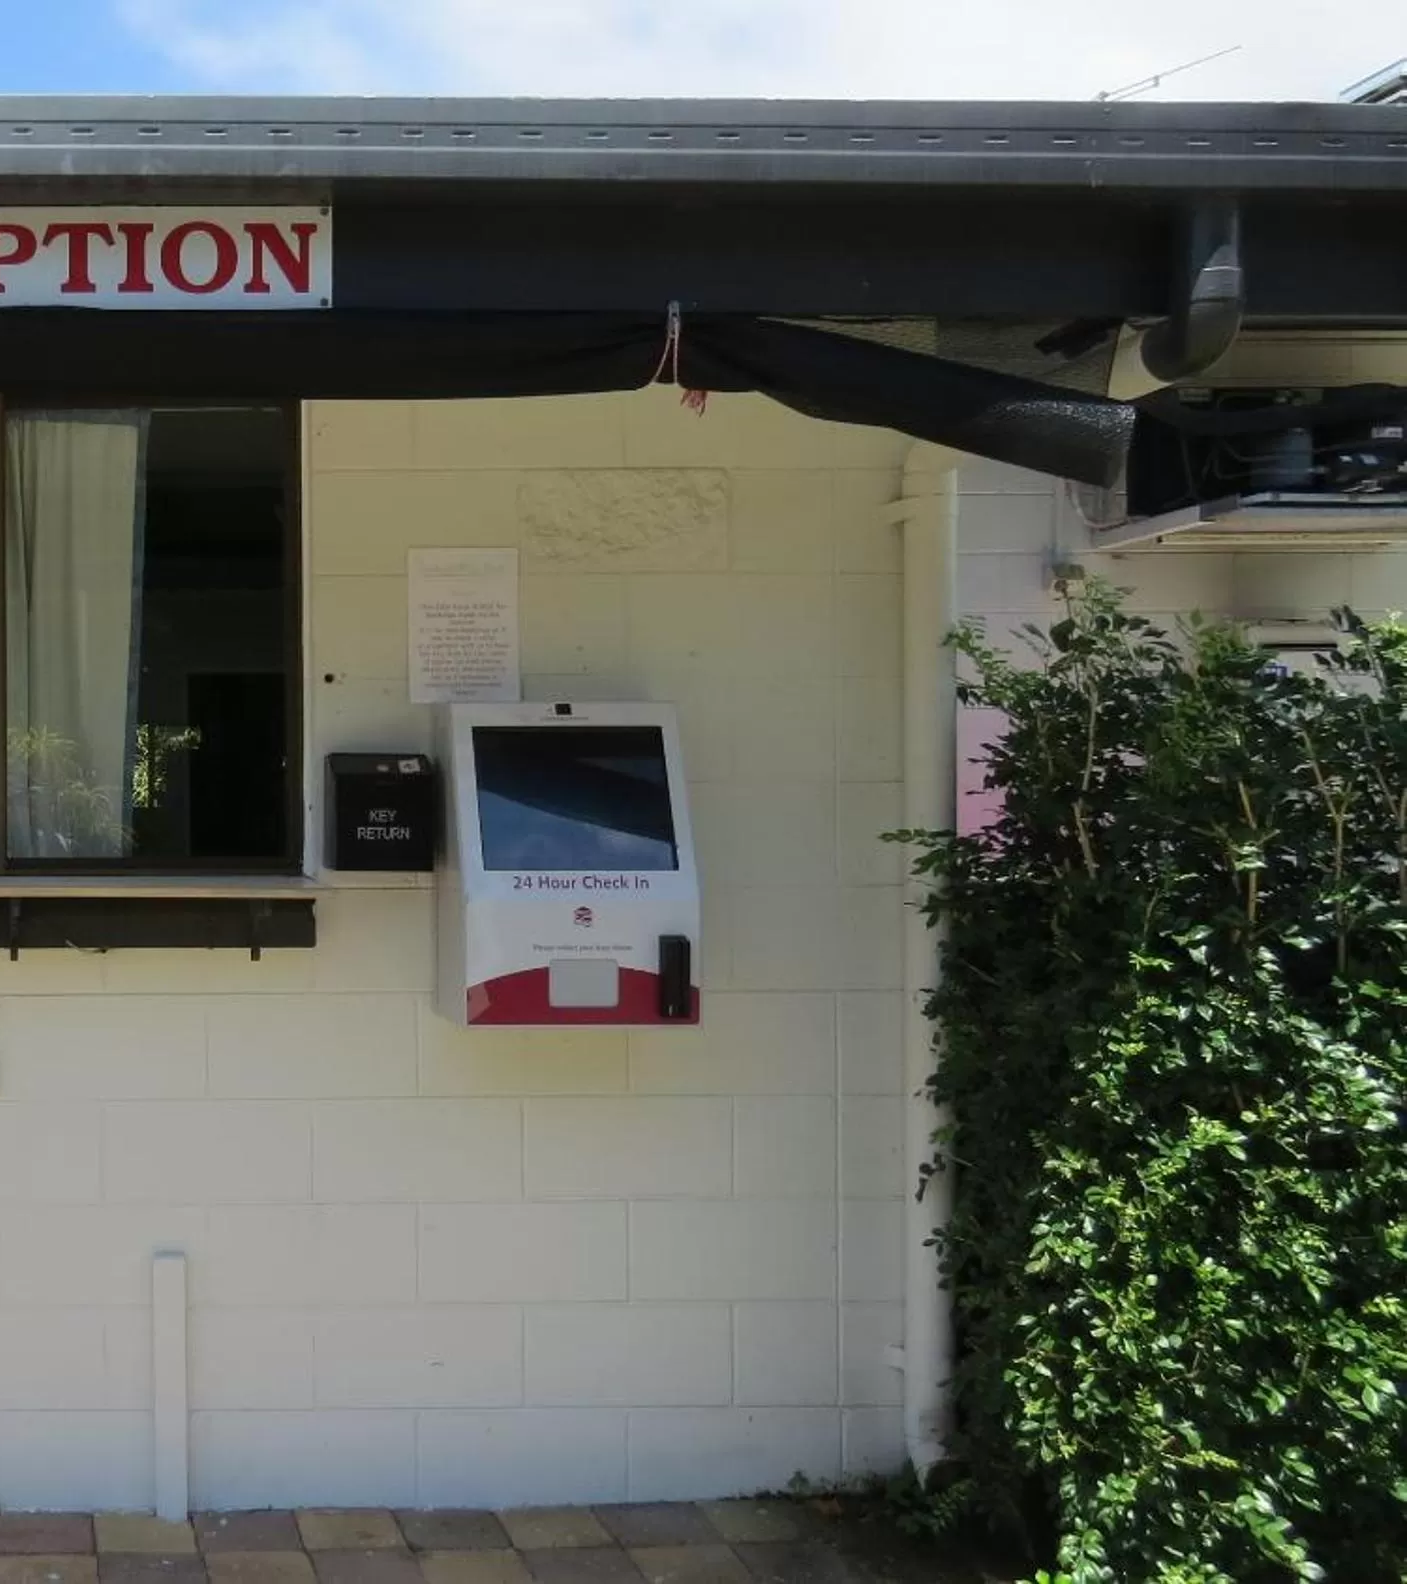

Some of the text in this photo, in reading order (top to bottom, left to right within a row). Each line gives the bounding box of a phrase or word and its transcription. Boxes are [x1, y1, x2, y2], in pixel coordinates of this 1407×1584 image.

[369, 810, 397, 822] KEY
[357, 827, 410, 840] RETURN
[513, 874, 650, 889] 24 Hour Check In
